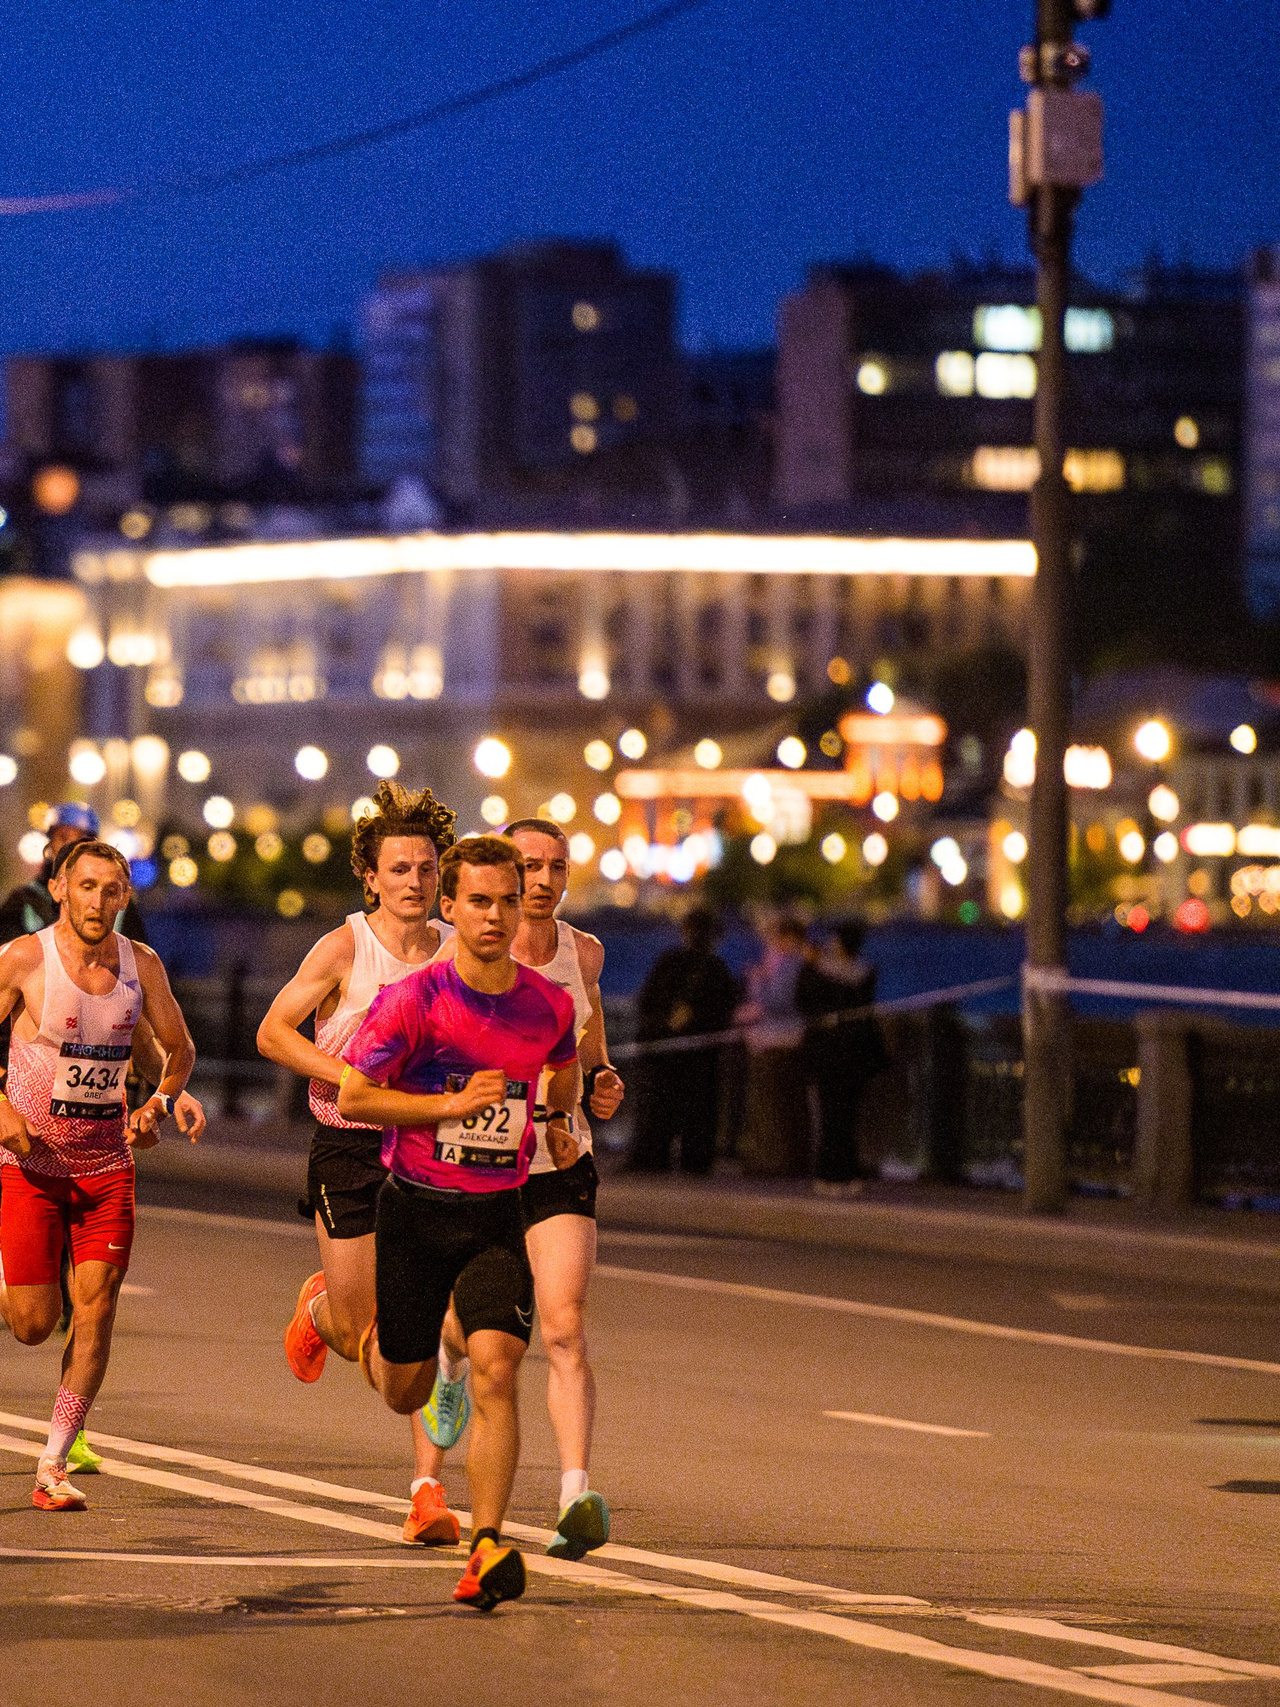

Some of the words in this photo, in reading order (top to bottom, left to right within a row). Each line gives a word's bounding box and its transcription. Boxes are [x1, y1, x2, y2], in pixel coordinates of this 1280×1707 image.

[66, 1065, 120, 1091] 3434
[84, 1090, 103, 1099] ОЛЕГ
[57, 1103, 67, 1115] A
[459, 1132, 509, 1144] АЛЕКСАНДР
[444, 1147, 456, 1162] A
